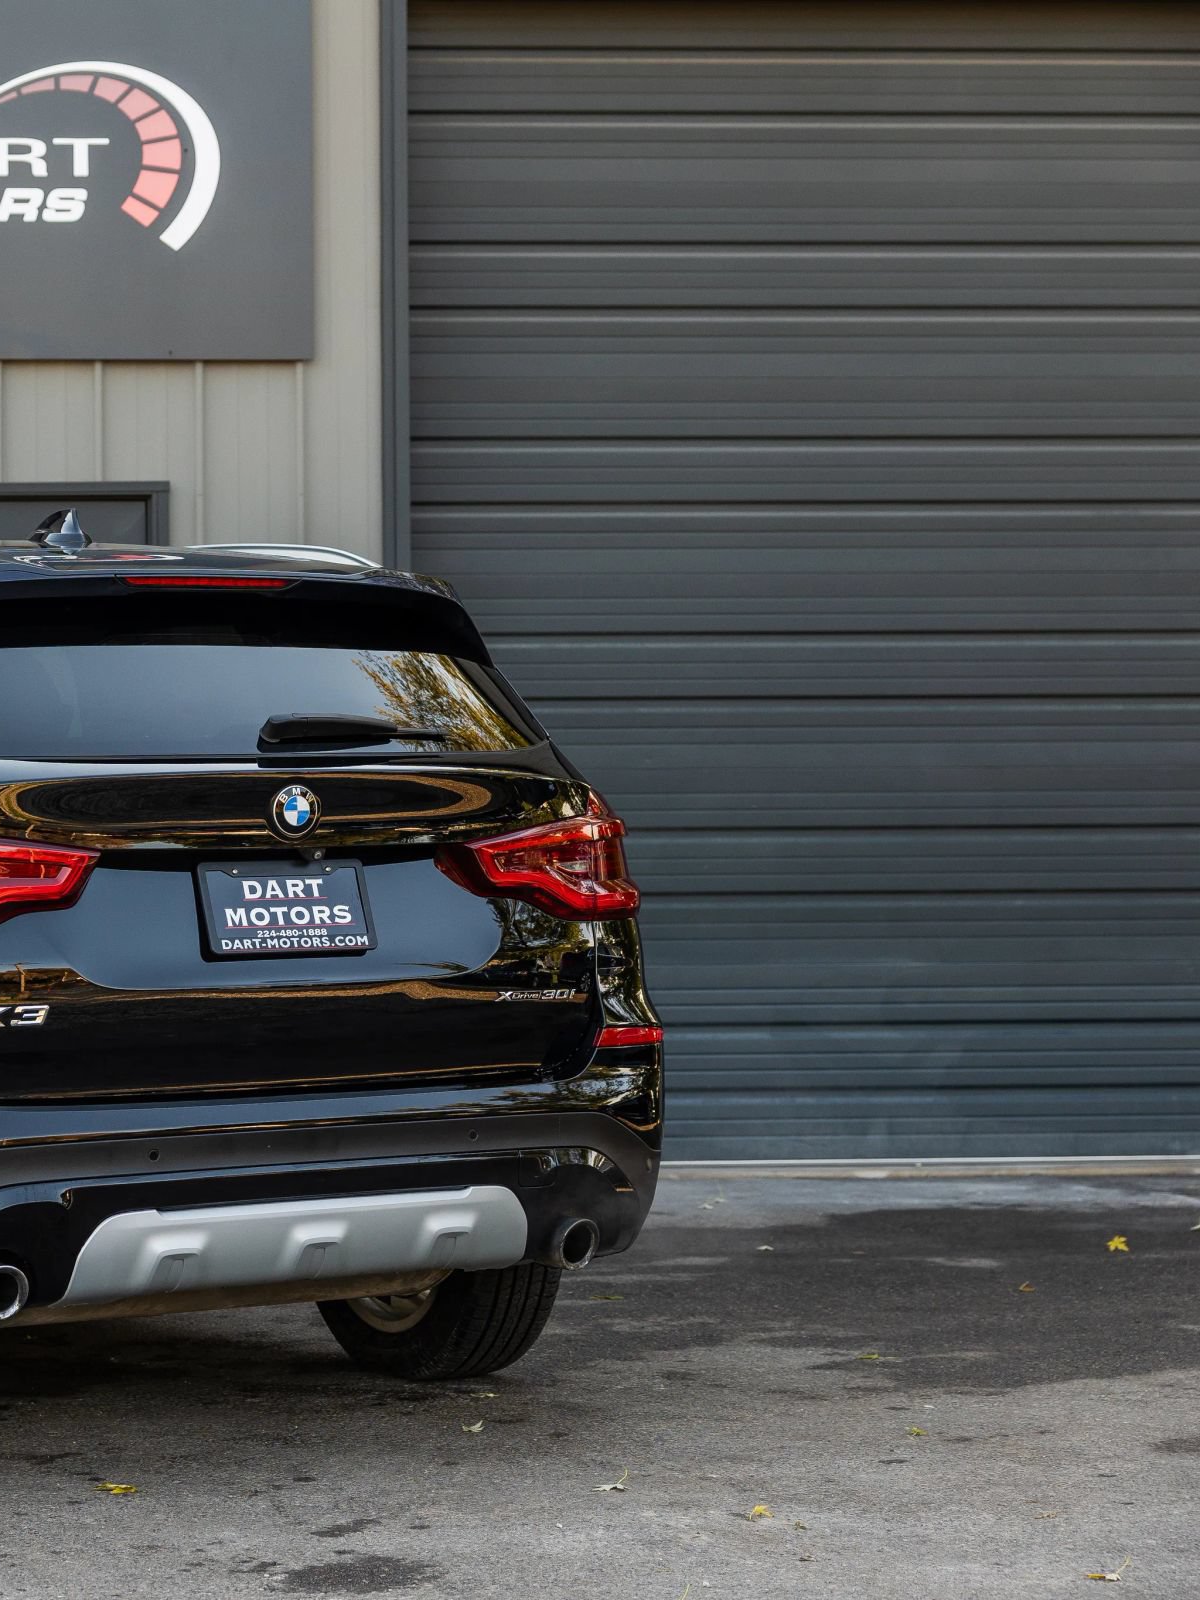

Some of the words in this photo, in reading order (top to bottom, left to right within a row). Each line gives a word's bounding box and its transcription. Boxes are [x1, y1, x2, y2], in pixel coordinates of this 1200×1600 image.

[279, 787, 315, 804] BMW
[241, 878, 323, 899] DART
[224, 905, 352, 927] MOTORS
[257, 928, 328, 938] 224-480-1888
[221, 935, 369, 950] DART-MOTORS.COM
